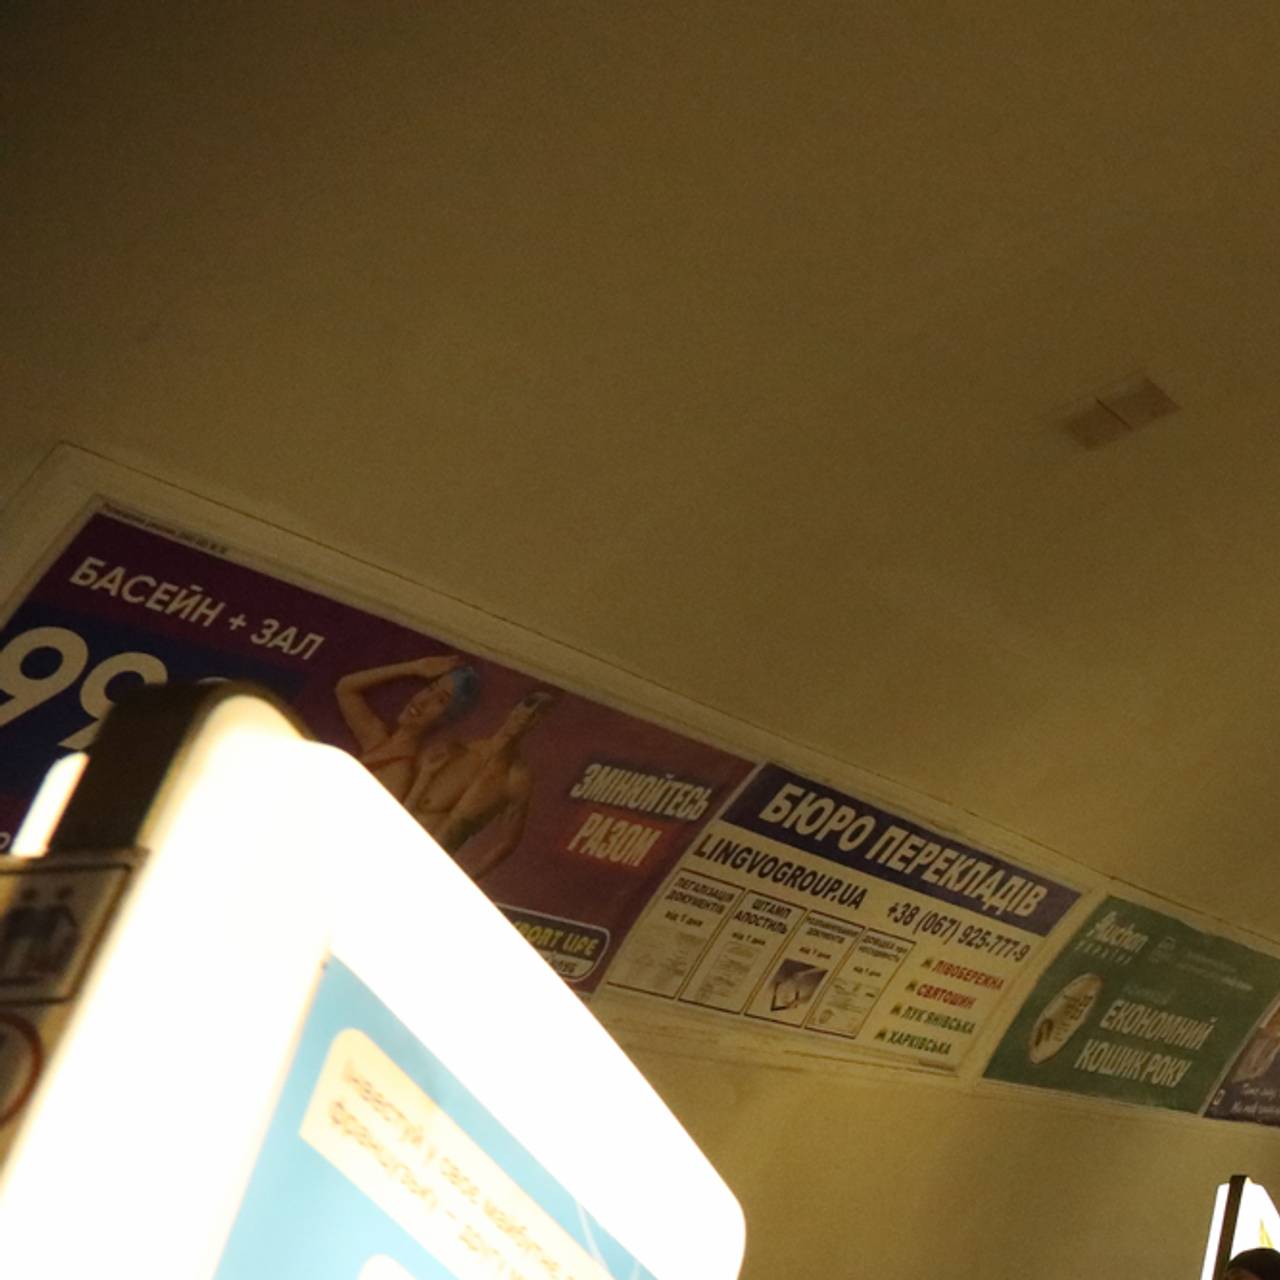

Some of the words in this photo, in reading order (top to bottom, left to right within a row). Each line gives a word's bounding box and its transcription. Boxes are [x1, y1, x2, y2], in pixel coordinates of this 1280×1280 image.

[68, 556, 226, 627] БАСЕЙН
[228, 613, 247, 633] +
[249, 619, 326, 660] ЗАЛ
[0, 625, 232, 751] 99
[569, 762, 713, 822] ЗМІНЮЙТЕСЬ
[567, 812, 663, 868] РАЗОМ
[758, 782, 869, 853] БЮРО
[866, 826, 1049, 918] ПЕРЕКЛАДІВ
[693, 833, 869, 912] LINGVOGROUP.UA
[563, 934, 600, 957] LIFE
[887, 902, 920, 926] +38
[911, 909, 963, 945] (067)
[957, 924, 1031, 963] 925-777-9
[916, 983, 977, 1009] СВЯТОШИН
[931, 959, 1005, 991] ЛІВОБЕРЕЖНА
[886, 1030, 952, 1056] ХАРКІВСЬКА
[1099, 998, 1219, 1051] ЕКОНОМНИЙ
[1074, 1039, 1146, 1083] КОШИК
[1141, 1052, 1193, 1088] РОКУ
